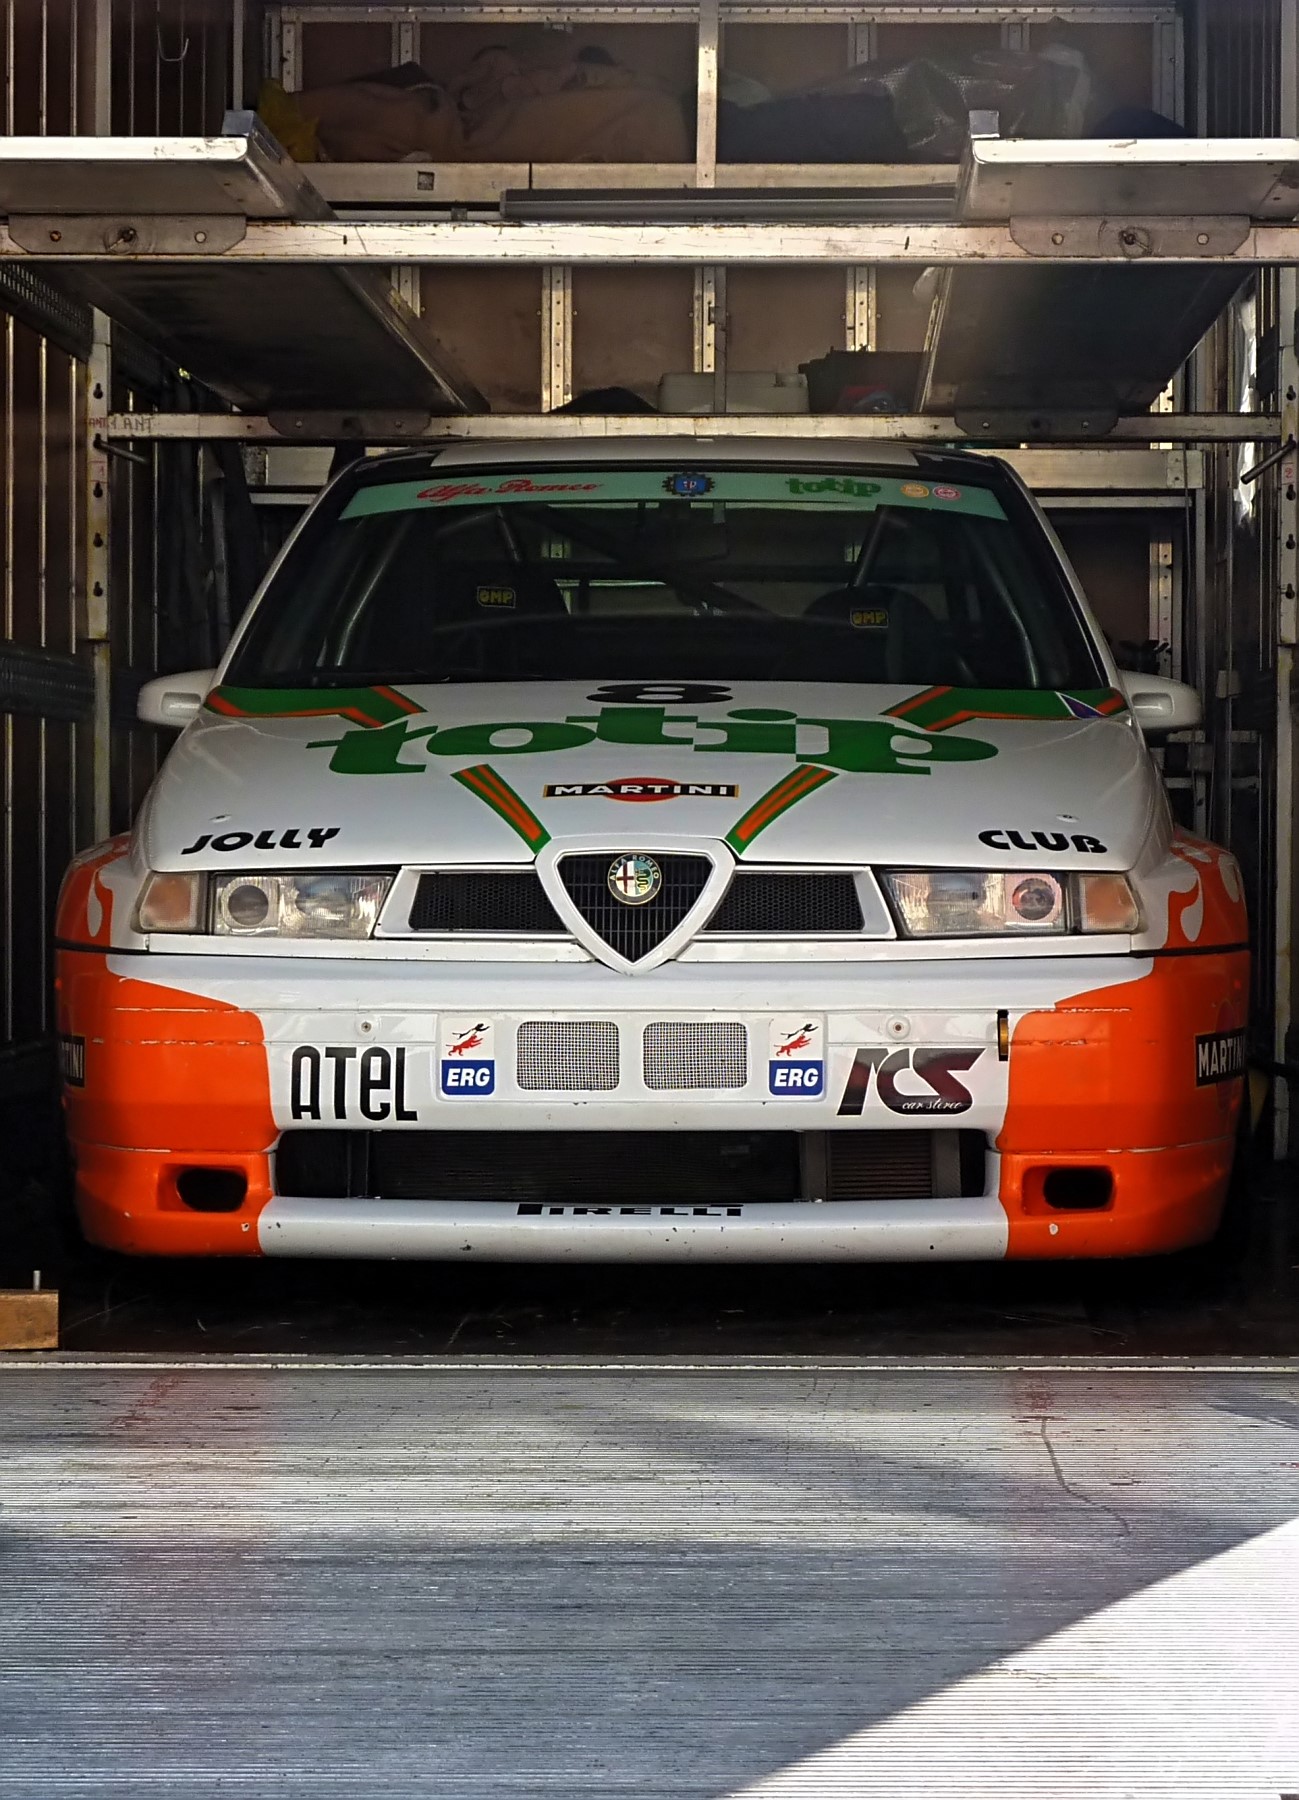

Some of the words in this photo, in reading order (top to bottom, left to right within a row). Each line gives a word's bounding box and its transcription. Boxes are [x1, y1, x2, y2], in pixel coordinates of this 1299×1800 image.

[416, 482, 492, 503] Alfa
[495, 479, 603, 494] Romeo
[785, 477, 882, 498] totip
[479, 589, 513, 605] OMP
[852, 610, 886, 625] OMP
[586, 680, 733, 704] 8
[306, 707, 999, 775] totip
[554, 784, 729, 796] MARTINI
[180, 827, 342, 856] JOLLY
[977, 829, 1109, 854] CLUB
[609, 857, 627, 881] ALFA
[632, 854, 660, 880] ROMEO
[446, 1067, 491, 1088] ERG
[773, 1067, 819, 1088] ERG
[901, 1101, 924, 1111] car
[925, 1096, 964, 1111] stereo
